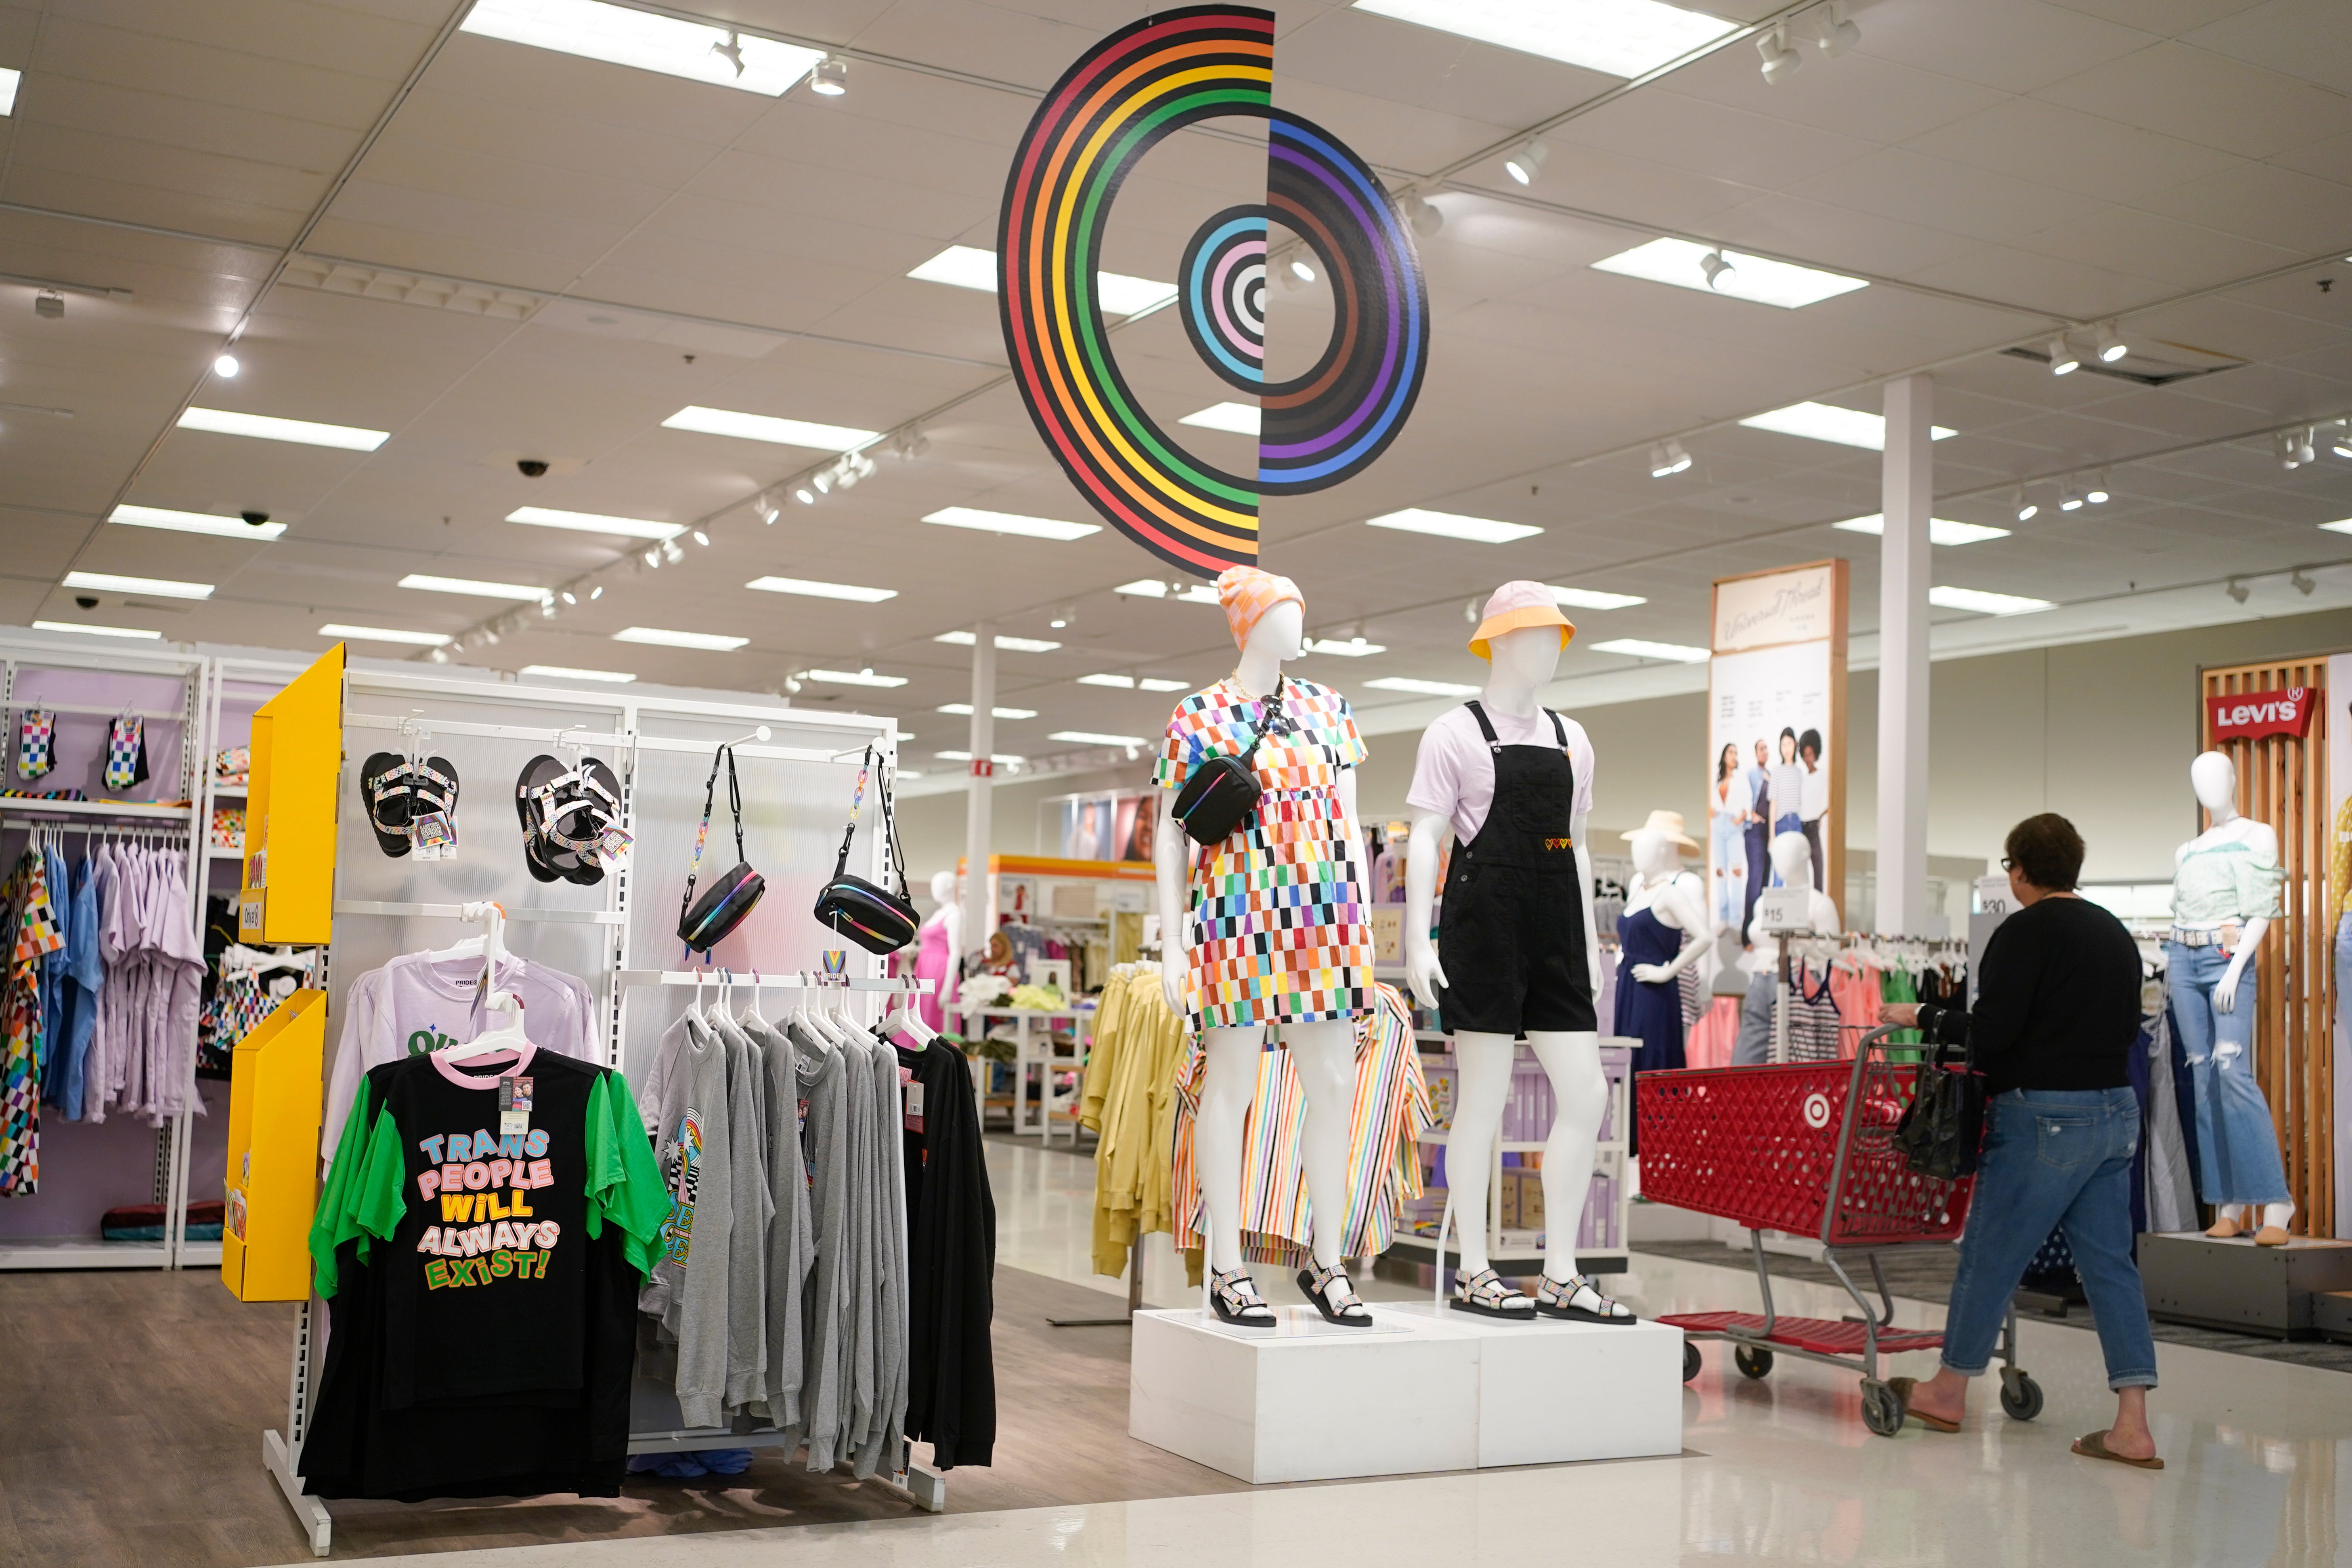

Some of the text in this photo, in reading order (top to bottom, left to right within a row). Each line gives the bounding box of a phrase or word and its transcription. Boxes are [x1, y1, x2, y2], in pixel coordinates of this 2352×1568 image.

[421, 826, 441, 834] DESIGN
[605, 833, 621, 849] DESIGN
[611, 836, 624, 848] PRIDE
[611, 838, 626, 853] COLLECTION
[251, 909, 255, 924] at
[1765, 908, 1783, 922] $15
[419, 1129, 549, 1164] TRANS
[417, 1158, 554, 1201] PEOPLE
[417, 1220, 560, 1257] ALWAYS
